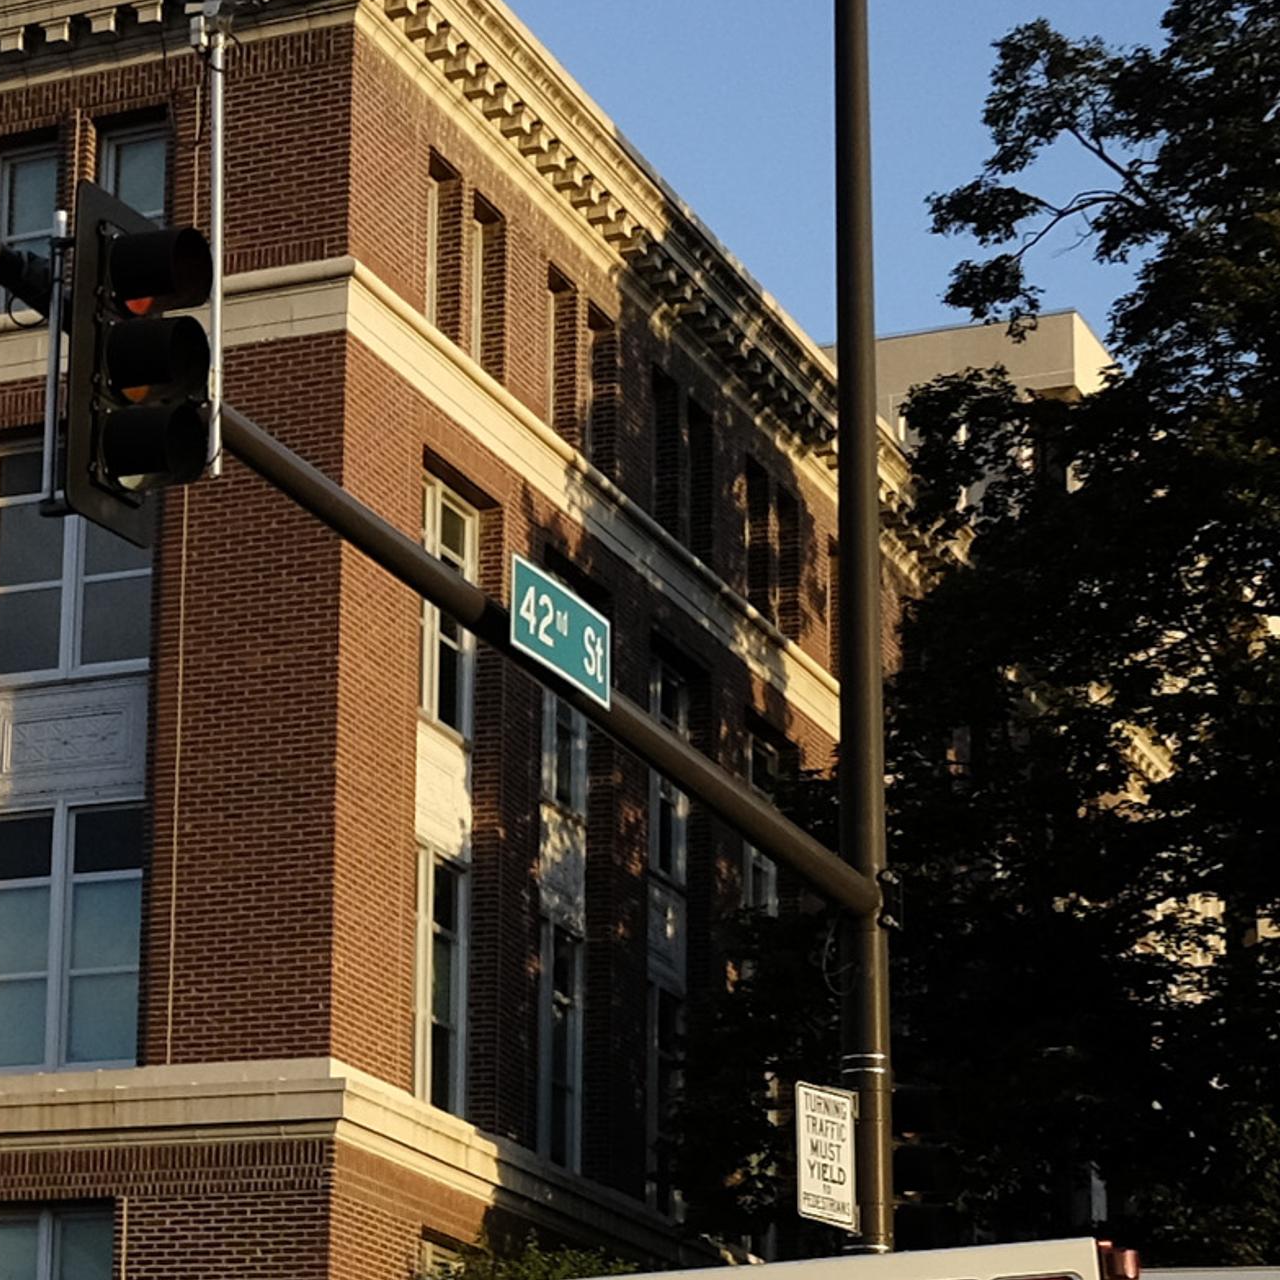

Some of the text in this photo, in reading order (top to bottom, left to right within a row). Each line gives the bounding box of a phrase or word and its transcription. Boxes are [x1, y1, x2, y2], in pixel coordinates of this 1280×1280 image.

[583, 626, 603, 683] St
[803, 1091, 847, 1120] TURNING
[805, 1114, 847, 1143] TRAFFIC
[810, 1138, 842, 1162] MUST
[807, 1159, 846, 1185] YIELD
